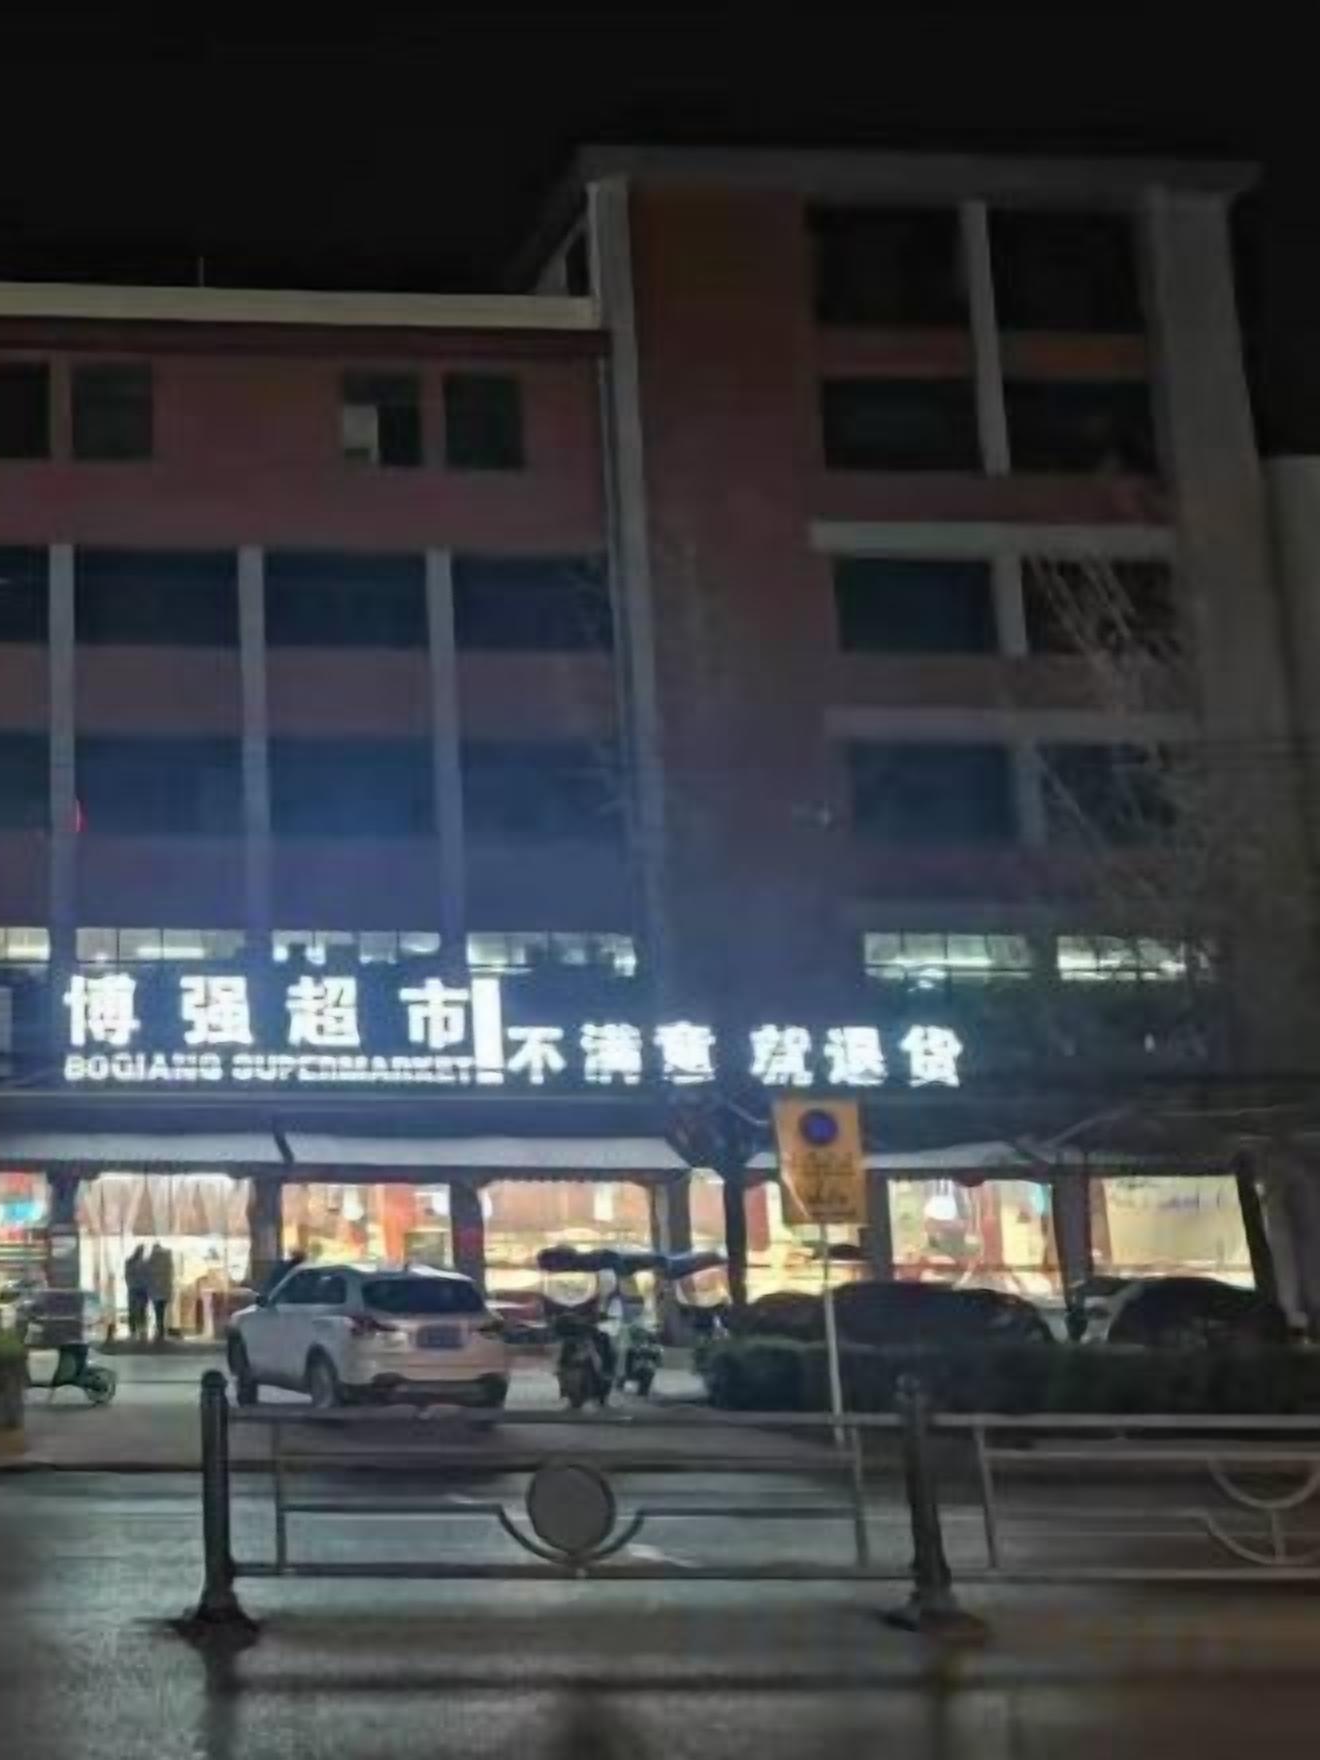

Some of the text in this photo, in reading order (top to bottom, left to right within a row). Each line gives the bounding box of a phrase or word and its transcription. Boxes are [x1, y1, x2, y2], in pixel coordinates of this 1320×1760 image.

[64, 974, 469, 1048] 博强超市
[64, 1053, 474, 1084] BOQIANG SUPERMARKET
